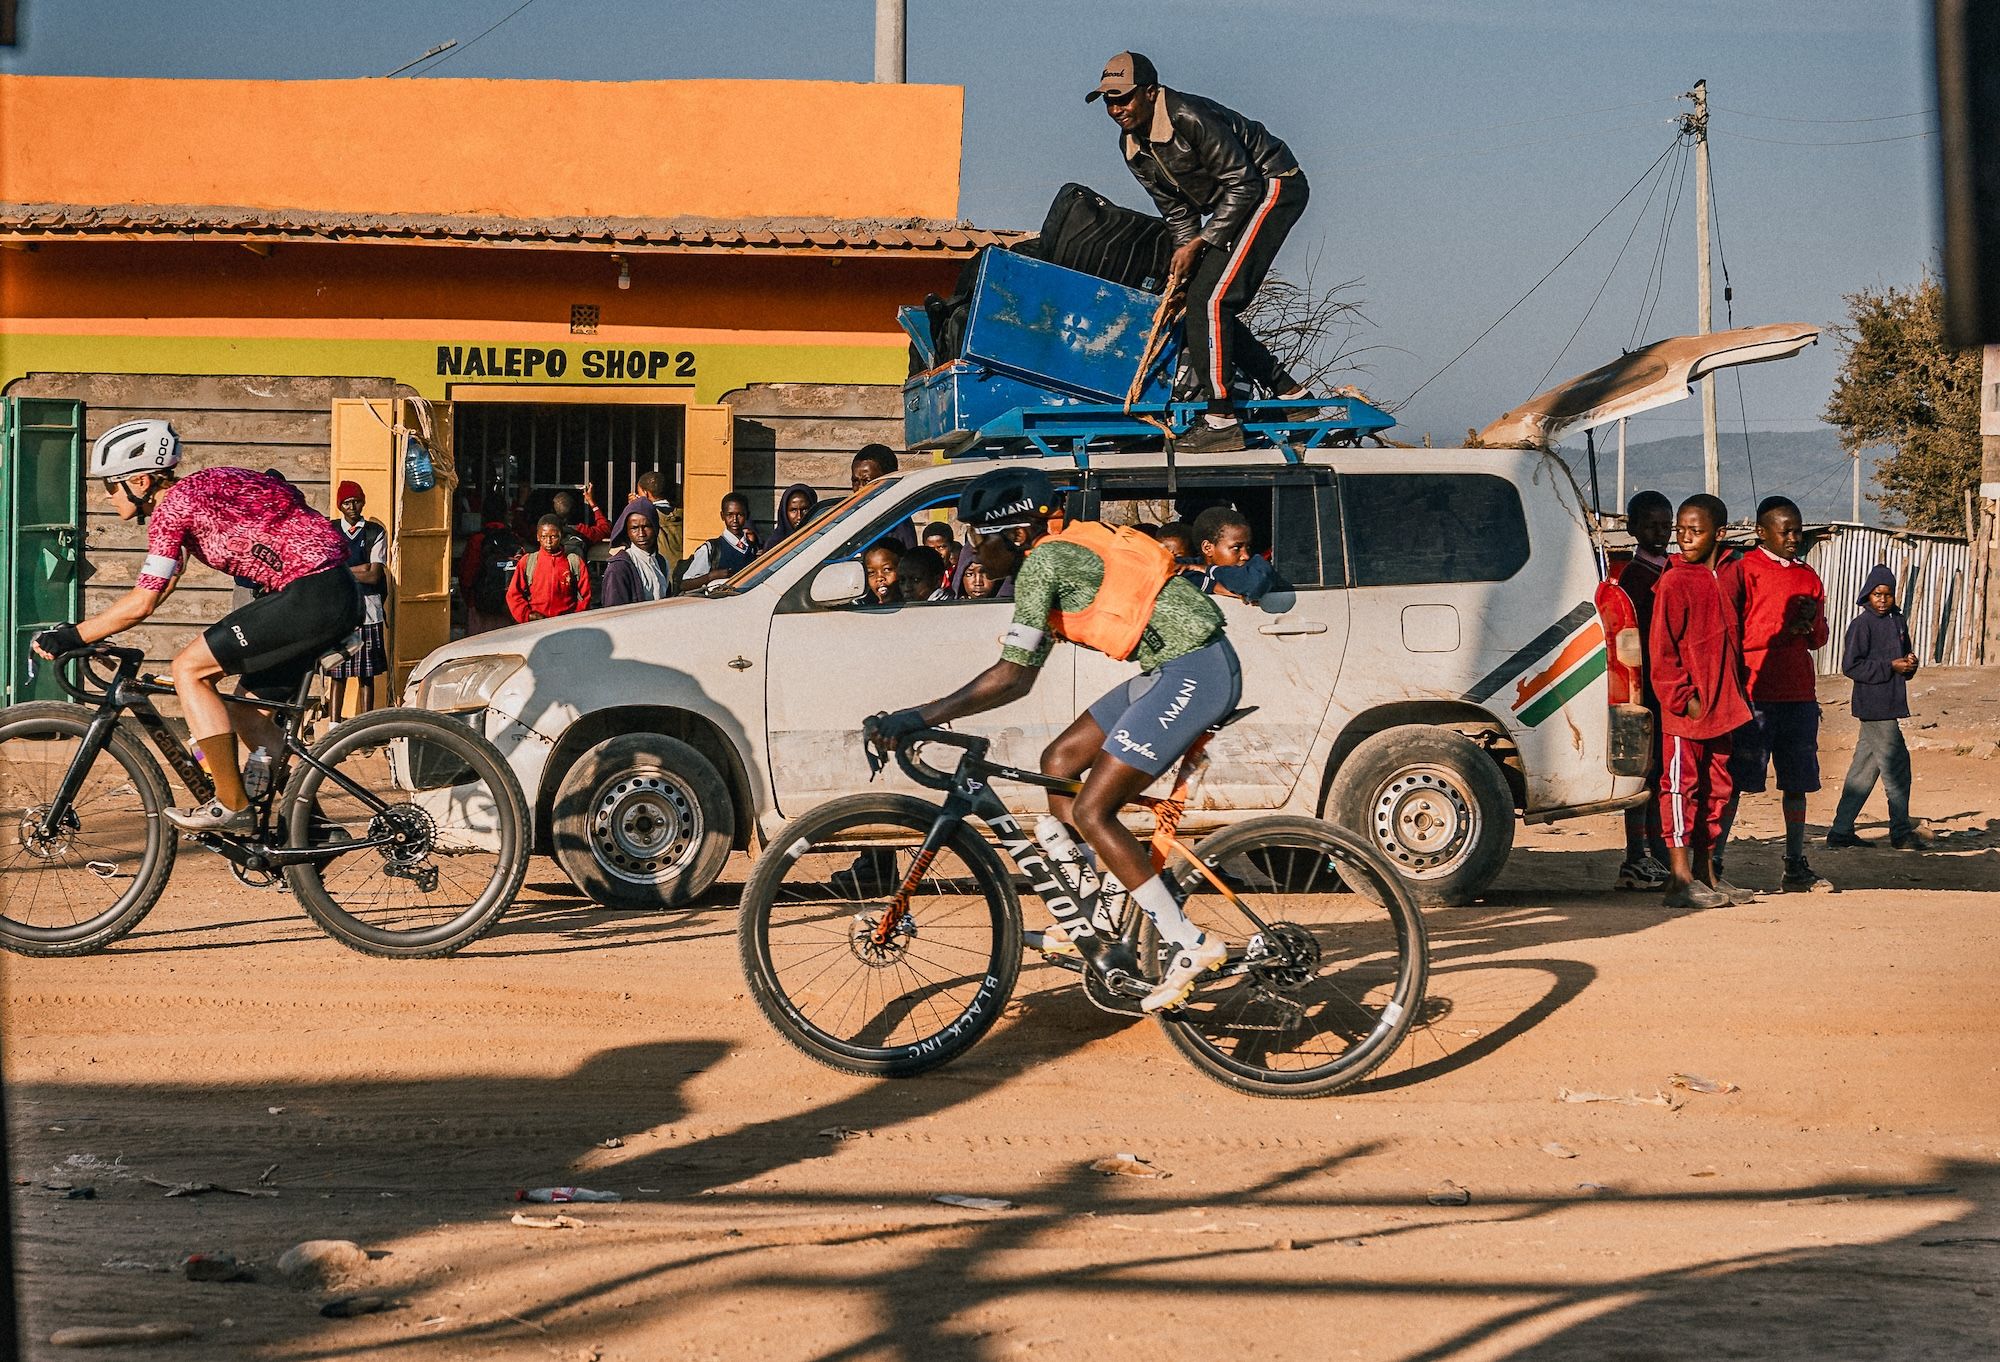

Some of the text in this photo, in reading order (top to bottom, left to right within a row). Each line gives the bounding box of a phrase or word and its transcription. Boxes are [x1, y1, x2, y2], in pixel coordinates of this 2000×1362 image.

[437, 346, 696, 379] NALEPO SHOP 2
[155, 437, 169, 466] POC
[985, 498, 1034, 521] AMANI
[230, 625, 249, 647] POC
[1158, 678, 1198, 730] AMANI
[1113, 729, 1158, 760] Rapha
[986, 813, 1096, 942] FACTOR
[908, 974, 999, 1059] BLACK INC
